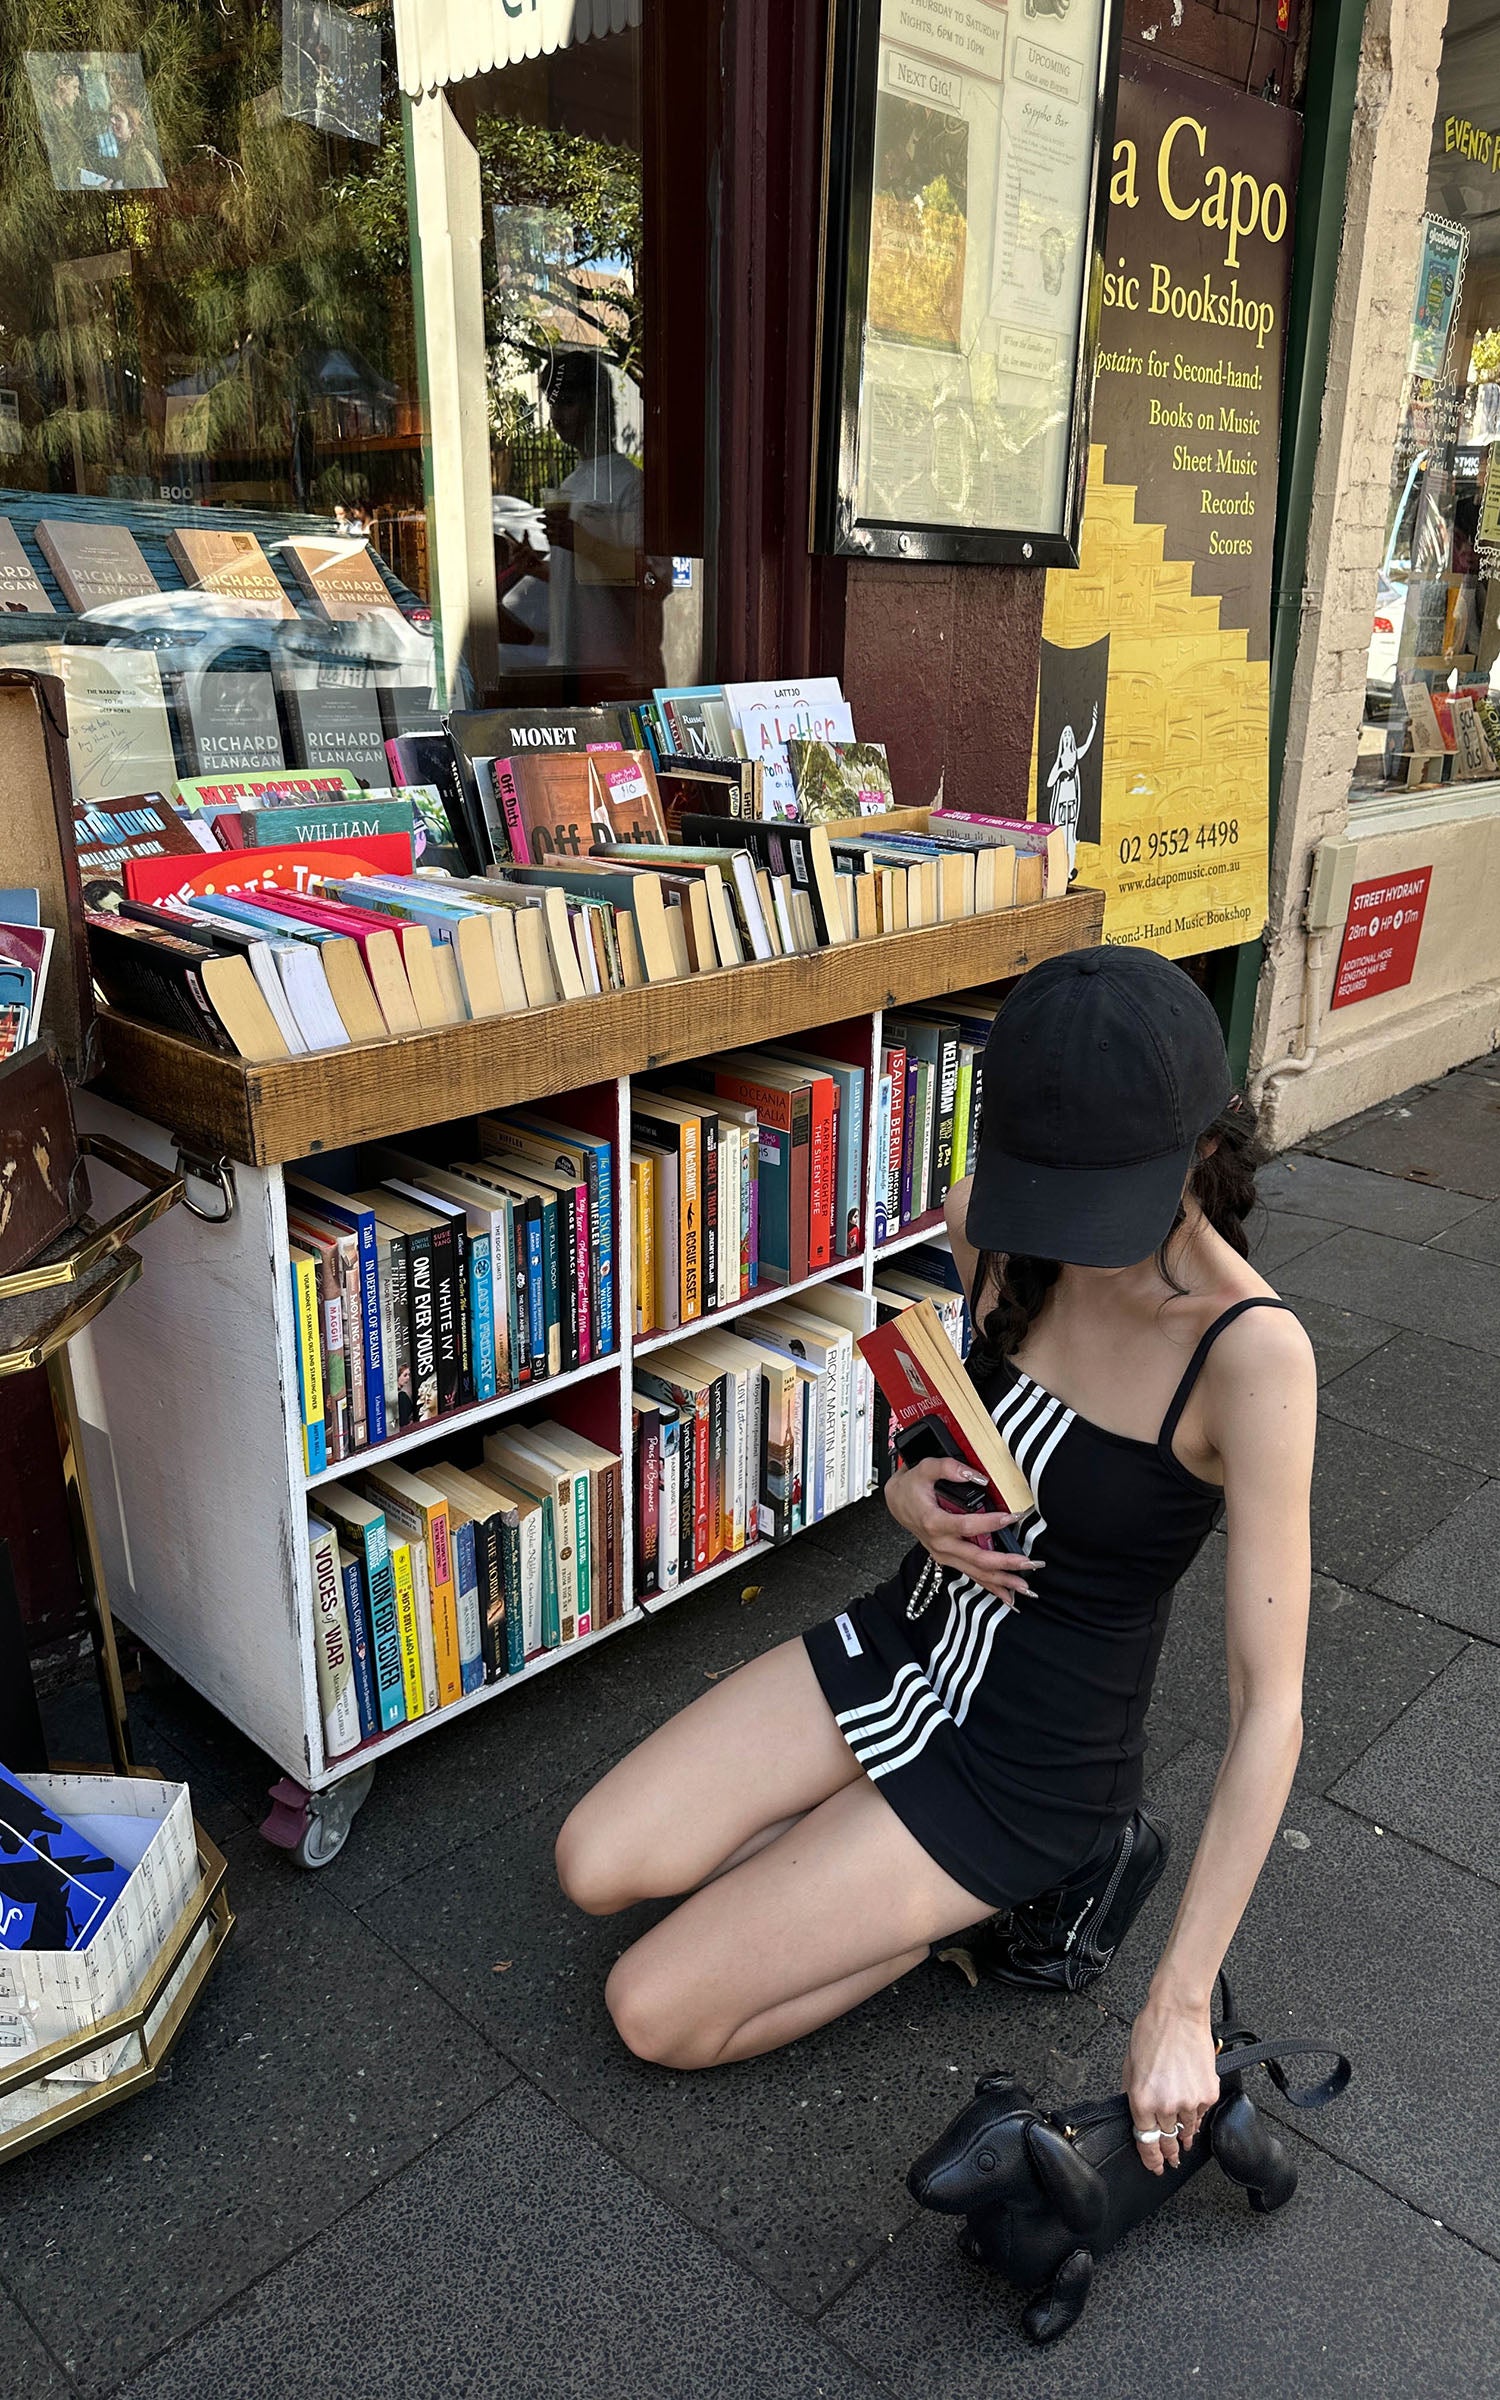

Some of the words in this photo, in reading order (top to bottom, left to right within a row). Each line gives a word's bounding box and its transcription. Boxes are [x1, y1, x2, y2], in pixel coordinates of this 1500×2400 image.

[898, 63, 927, 88] NEXT
[1028, 48, 1071, 77] UPCOMING
[1022, 103, 1052, 128] Sappho
[1055, 113, 1069, 128] Bar
[1445, 115, 1492, 164] EVENTS
[1110, 139, 1139, 208] a
[1157, 116, 1287, 269] Capo
[1103, 257, 1139, 310] sic
[1148, 262, 1274, 349] Bookshop
[1095, 348, 1143, 378] pstairs
[1147, 349, 1169, 378] for
[1173, 353, 1263, 391] Second-hand:
[1149, 399, 1193, 429] Books
[1197, 412, 1215, 431] on
[1218, 407, 1261, 435] Music
[1173, 444, 1213, 473] Sheet
[1216, 448, 1257, 476] Music
[1200, 489, 1255, 516] Records
[1209, 530, 1253, 555] Scores
[72, 568, 154, 585] RICHARD
[203, 574, 277, 588] RICHARD
[316, 579, 384, 592] RICHARD
[323, 592, 391, 603] FLANAGAN
[774, 688, 800, 698] LATTJO
[200, 735, 279, 751] RICHARD
[307, 731, 381, 747] RICHARD
[510, 727, 577, 747] MONET
[760, 723, 773, 750] A
[203, 754, 282, 770] FLANAGAN
[310, 749, 383, 764] FLANAGAN
[500, 774, 513, 794] Off
[114, 808, 167, 836] WHO
[505, 798, 519, 829] Duty
[295, 820, 380, 843] WILLIAM
[531, 823, 581, 864] Off
[1120, 836, 1141, 864] 02
[1148, 828, 1189, 859] 9552
[1195, 819, 1239, 849] 4498
[78, 846, 134, 868] BRILLIANT
[133, 840, 165, 856] BOOK
[1118, 860, 1241, 893] www.dacapomusic.com.au
[1353, 889, 1386, 911] STREET
[1386, 879, 1425, 902] HYDRANT
[1105, 920, 1172, 946] Second-Hand
[1175, 916, 1204, 932] Music
[1207, 906, 1252, 926] Bookshop
[1348, 924, 1368, 941] 28m
[1381, 915, 1393, 932] HP
[1340, 966, 1367, 985] LENGTHS
[1366, 963, 1379, 975] MAY
[1379, 961, 1388, 972] BE
[1342, 951, 1378, 972] ADDITIONAL
[1377, 947, 1393, 961] HOSE
[1338, 979, 1367, 996] REQUIRED
[891, 1052, 904, 1111] ISAIAH
[940, 1040, 957, 1114] KELLERMAN
[739, 1085, 786, 1108] OCEANIA
[853, 1080, 861, 1117] Lana's
[685, 1127, 697, 1150] ANDY
[822, 1119, 830, 1150] KARIN
[889, 1117, 900, 1171] BERLIN
[600, 1156, 608, 1169] The
[686, 1151, 697, 1202] McDERMOTT
[707, 1151, 717, 1187] GREAT
[813, 1149, 821, 1184] SILENT
[599, 1172, 610, 1210] LUCKY
[813, 1189, 821, 1214] WIFE
[821, 1156, 829, 1217] SLAUGHTER
[576, 1197, 587, 1214] Kay
[707, 1190, 717, 1227] TRIALS
[364, 1224, 374, 1249] Tallis
[590, 1201, 599, 1246] NIFFLER
[599, 1214, 611, 1256] ESCAPE
[569, 1235, 575, 1244] IS
[576, 1240, 587, 1267] Please
[686, 1231, 697, 1266] ROGUE
[366, 1260, 375, 1271] IN
[413, 1257, 431, 1289] ONLY
[366, 1273, 379, 1315] DEFENCE
[399, 1258, 409, 1306] BURNING
[439, 1278, 452, 1313] WHITE
[686, 1269, 697, 1301] ASSET
[415, 1293, 433, 1327] EVER
[476, 1279, 490, 1319] LADY
[577, 1297, 589, 1314] Hug
[306, 1314, 314, 1341] STARTING
[329, 1306, 339, 1344] MAGGIE
[349, 1293, 360, 1342] MOVING
[368, 1316, 379, 1329] OF
[369, 1330, 381, 1370] REALISM
[416, 1328, 434, 1377] YOURS
[441, 1335, 453, 1360] IVY
[477, 1321, 493, 1380] FRIDAY
[309, 1367, 317, 1394] STARTING
[352, 1345, 362, 1387] TARGET
[826, 1350, 838, 1393] RICKY
[714, 1381, 722, 1413] Lynda
[900, 1404, 919, 1420] tony
[919, 1395, 943, 1415] parsons
[683, 1421, 691, 1449] Lynda
[825, 1397, 836, 1452] MARTIN
[684, 1450, 690, 1461] La
[825, 1459, 835, 1480] ME
[577, 1480, 586, 1500] HOW
[578, 1502, 586, 1513] TO
[669, 1506, 677, 1537] ITALY
[682, 1490, 691, 1540] WIDOWS
[578, 1514, 587, 1539] BUILD
[366, 1527, 380, 1570] LEDWIDGE
[378, 1524, 387, 1563] MICHAEL
[487, 1532, 497, 1560] THE
[579, 1547, 587, 1565] GIRL
[315, 1545, 338, 1613] VOICES
[348, 1566, 361, 1609] CRESSIDA
[370, 1566, 396, 1607] RUN
[400, 1591, 411, 1613] OLSEN
[321, 1613, 337, 1625] of
[354, 1609, 364, 1643] COWELL
[374, 1604, 398, 1637] FOR
[403, 1614, 413, 1634] STARR
[324, 1625, 346, 1671] WAR
[404, 1635, 415, 1656] POPPY
[378, 1638, 401, 1692] COVER
